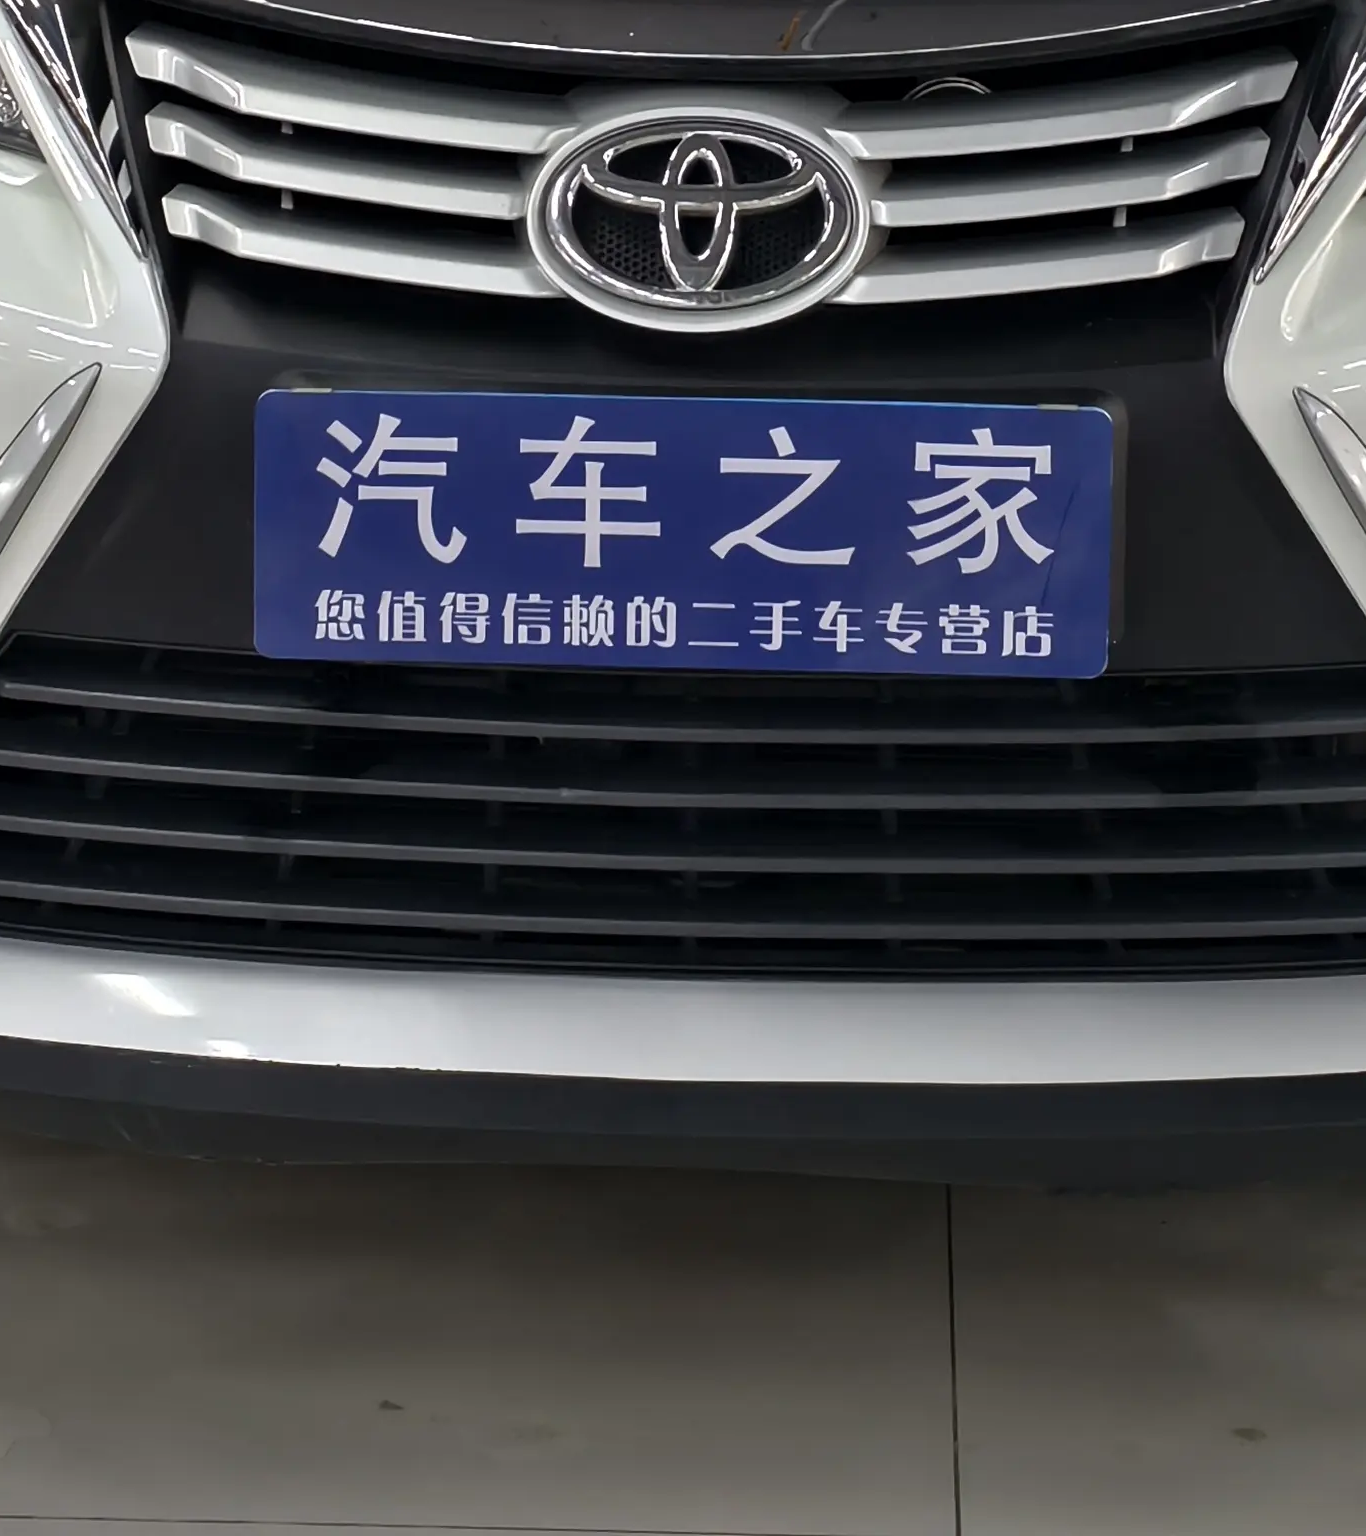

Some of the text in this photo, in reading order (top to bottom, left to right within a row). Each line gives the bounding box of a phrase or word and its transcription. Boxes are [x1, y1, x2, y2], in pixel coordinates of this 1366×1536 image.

[315, 413, 1055, 575] 汽车之家
[313, 588, 1054, 658] 您值得信赖的二手车专营店
